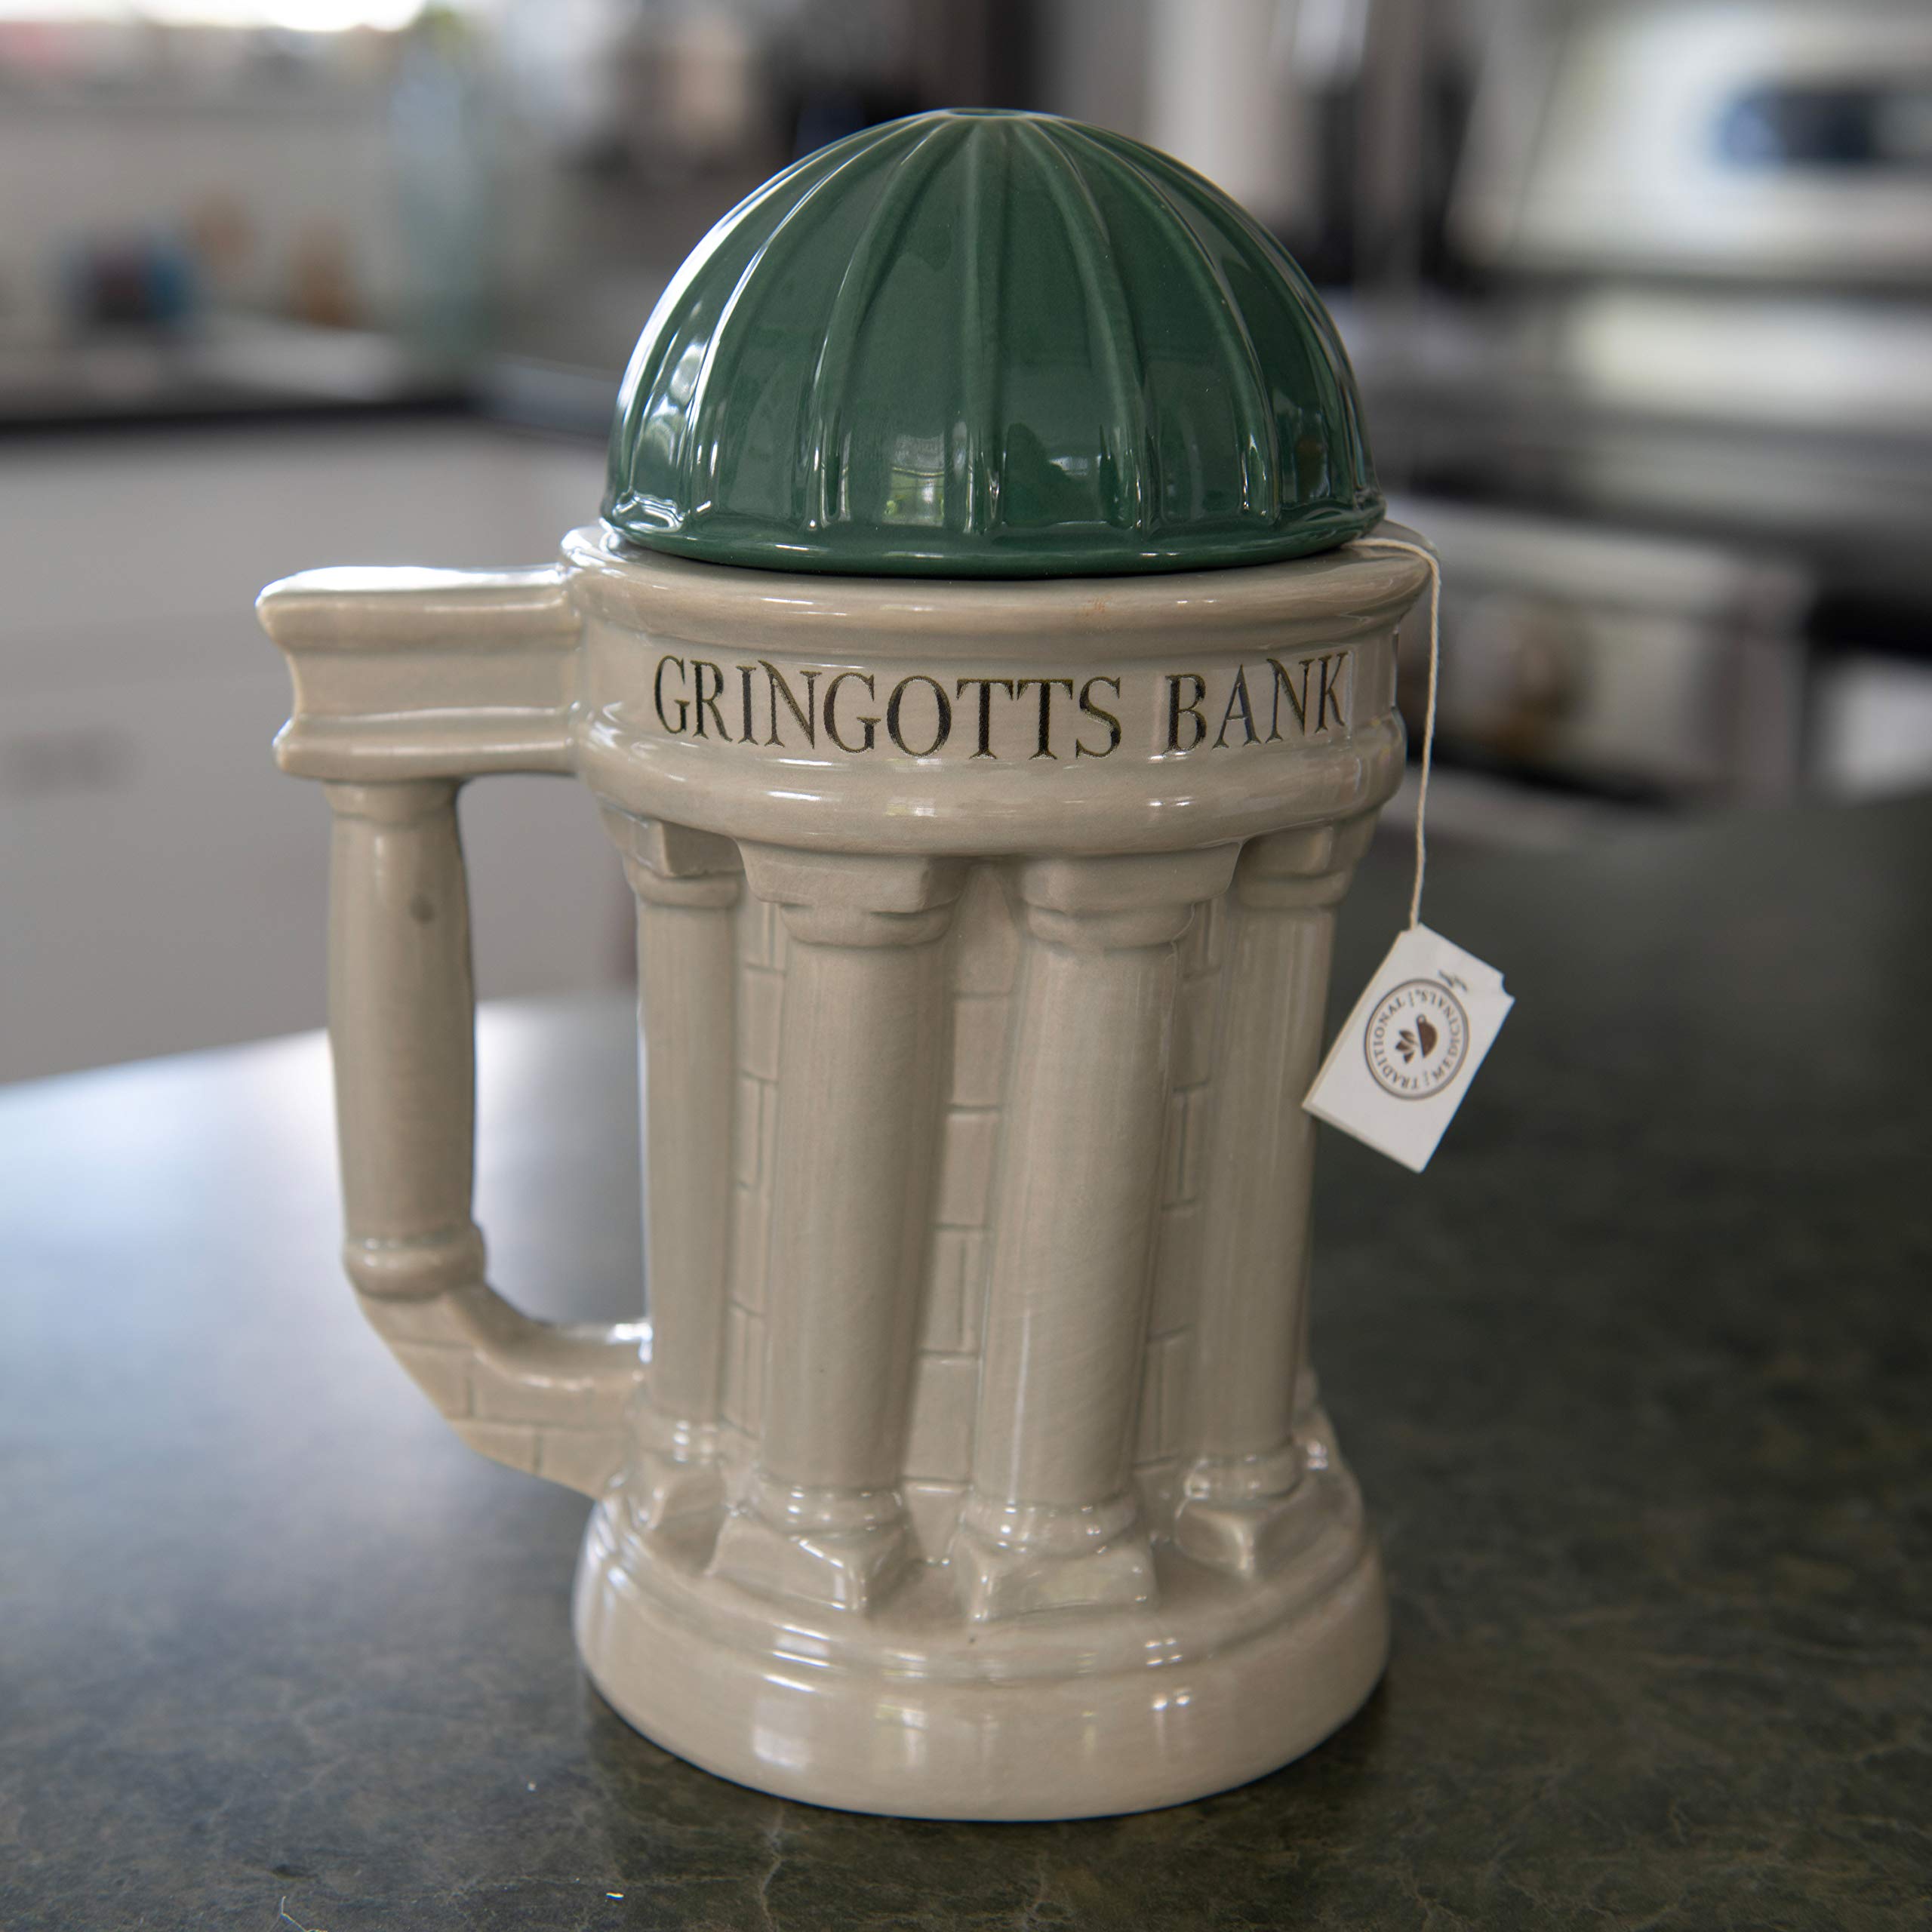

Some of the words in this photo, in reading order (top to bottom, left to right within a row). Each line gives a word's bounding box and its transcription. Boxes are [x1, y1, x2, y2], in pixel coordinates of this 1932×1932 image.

[654, 655, 1121, 761] GRINGOTTS
[1163, 652, 1348, 755] BANK
[1373, 997, 1419, 1089] TRADITIONAL
